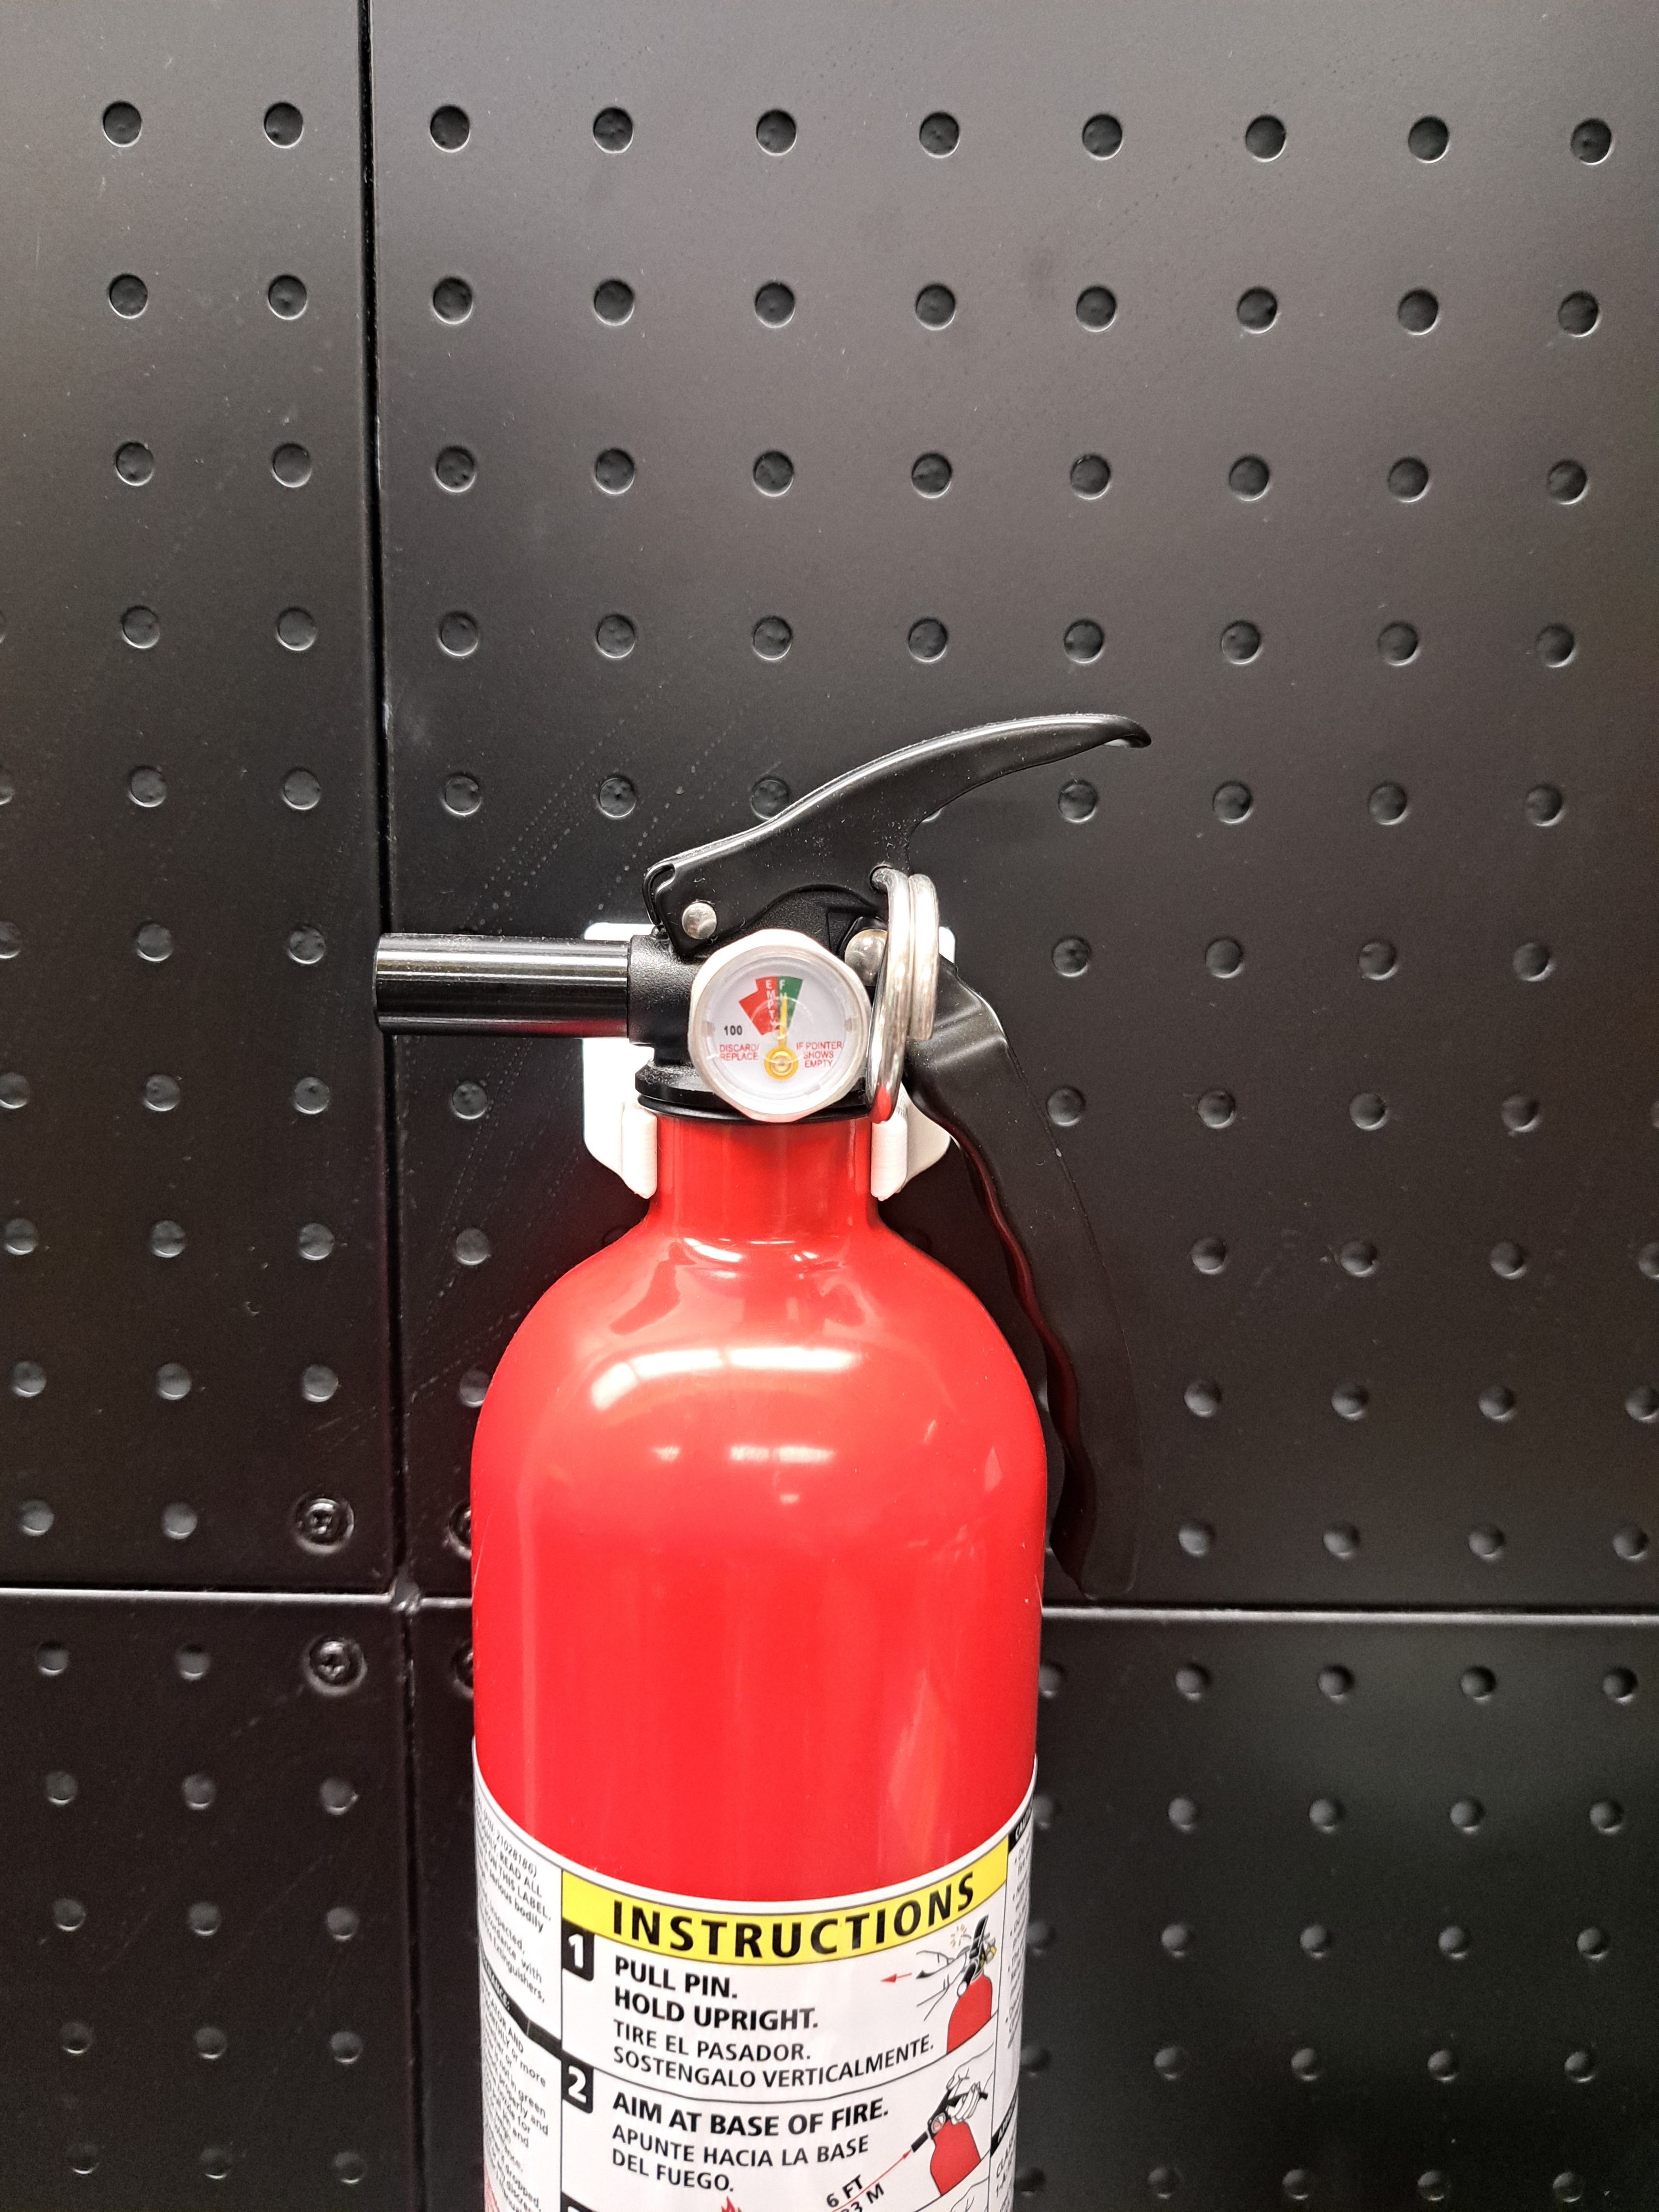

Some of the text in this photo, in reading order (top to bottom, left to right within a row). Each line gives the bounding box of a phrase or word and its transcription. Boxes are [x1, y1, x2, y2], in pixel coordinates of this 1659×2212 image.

[724, 1025, 742, 1036] 100
[796, 1041, 842, 1051] IF POINTER
[719, 1052, 758, 1061] REPLACE
[805, 1059, 832, 1068] EMPTY
[518, 1885, 551, 1921] LABEL.
[524, 1876, 542, 1899] ALL
[514, 1897, 543, 1933] bodily
[614, 1871, 973, 1958] INSTRUCTIONS
[568, 1934, 584, 1970] 1
[616, 1955, 738, 1999] PULL PIN.
[615, 1986, 818, 2031] HOLD UPRIGHT.
[614, 2019, 810, 2062] TIRE EL PASADOR.
[520, 2060, 546, 2087] more
[614, 2034, 934, 2088] SOSTENGALO VERTICALMENTE.
[568, 2065, 587, 2104] 2
[518, 2090, 545, 2118] green
[613, 2091, 888, 2136] AIM AT BASE OF FIRE.
[513, 2128, 529, 2147] and
[518, 2115, 530, 2134] for
[531, 2114, 548, 2136] and
[612, 2124, 869, 2167] APUNTE HACIA LA BASE
[613, 2148, 734, 2191] DEL FUEGO.
[826, 2174, 863, 2208] 6 FT
[866, 2182, 885, 2204] M
